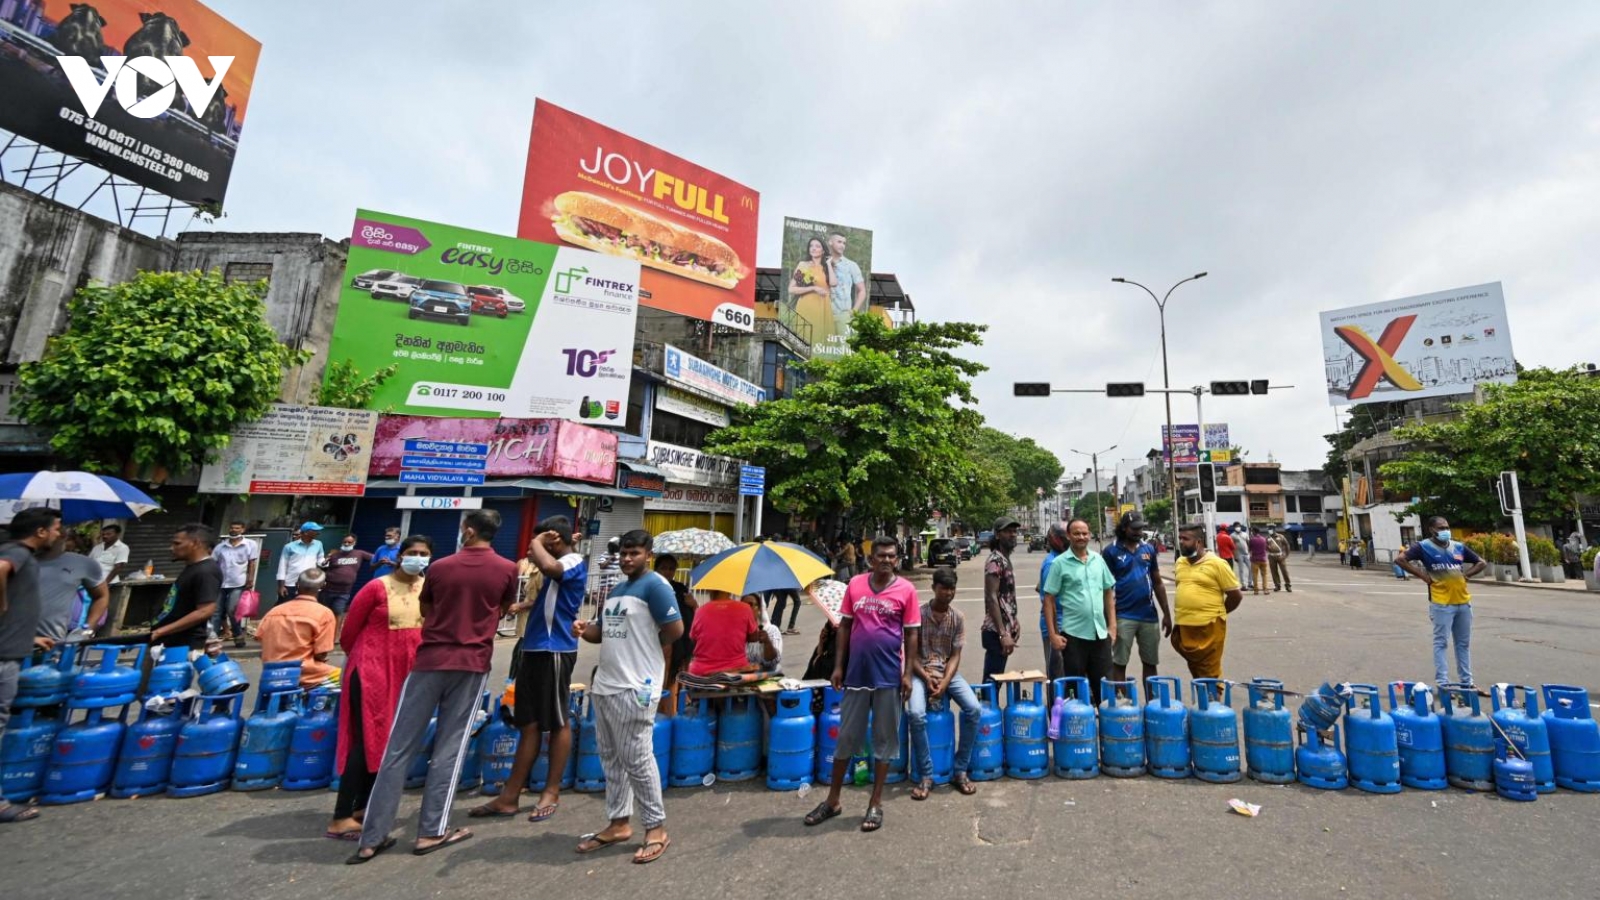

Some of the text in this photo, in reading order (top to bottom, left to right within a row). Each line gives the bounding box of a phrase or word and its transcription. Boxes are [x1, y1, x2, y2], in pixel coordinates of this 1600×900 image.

[59, 106, 84, 125] 075
[84, 118, 108, 136] 370
[141, 143, 162, 160] 075
[85, 132, 182, 183] WWW.CNSTEEL.CO
[786, 219, 813, 231] FASHION
[394, 241, 419, 254] easy
[457, 242, 493, 254] FINTREX
[440, 247, 504, 275] easy
[585, 276, 634, 292] FINTREX
[603, 288, 633, 301] finance
[725, 308, 751, 326] 660
[433, 387, 506, 403] 0117 200 100
[651, 446, 695, 468] SUBASINGHE
[695, 454, 717, 471] MOTOR
[427, 474, 464, 482] VIDYALAYA
[420, 497, 452, 508] CDB
